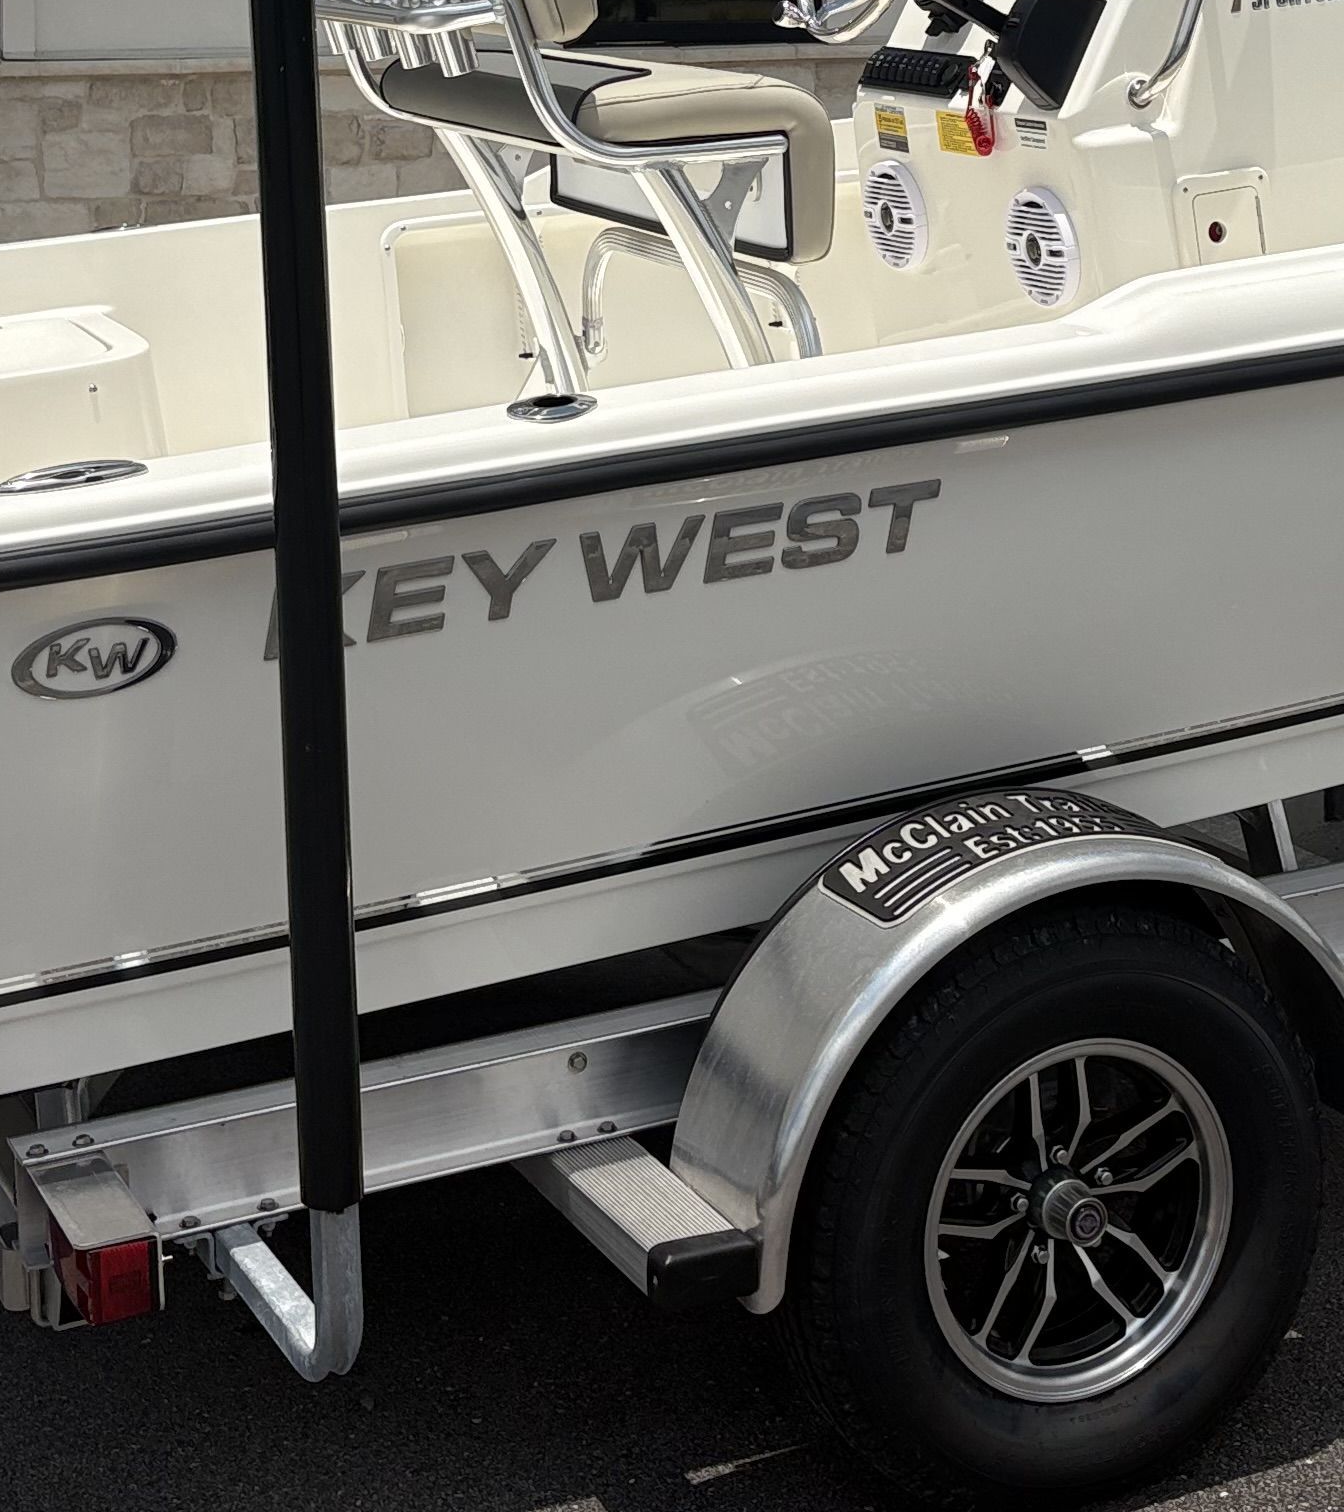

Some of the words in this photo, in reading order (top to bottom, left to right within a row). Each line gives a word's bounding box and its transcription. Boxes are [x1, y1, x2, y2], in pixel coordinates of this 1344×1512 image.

[579, 478, 942, 603] WEST
[45, 637, 150, 681] KW
[837, 802, 1013, 893] McClain
